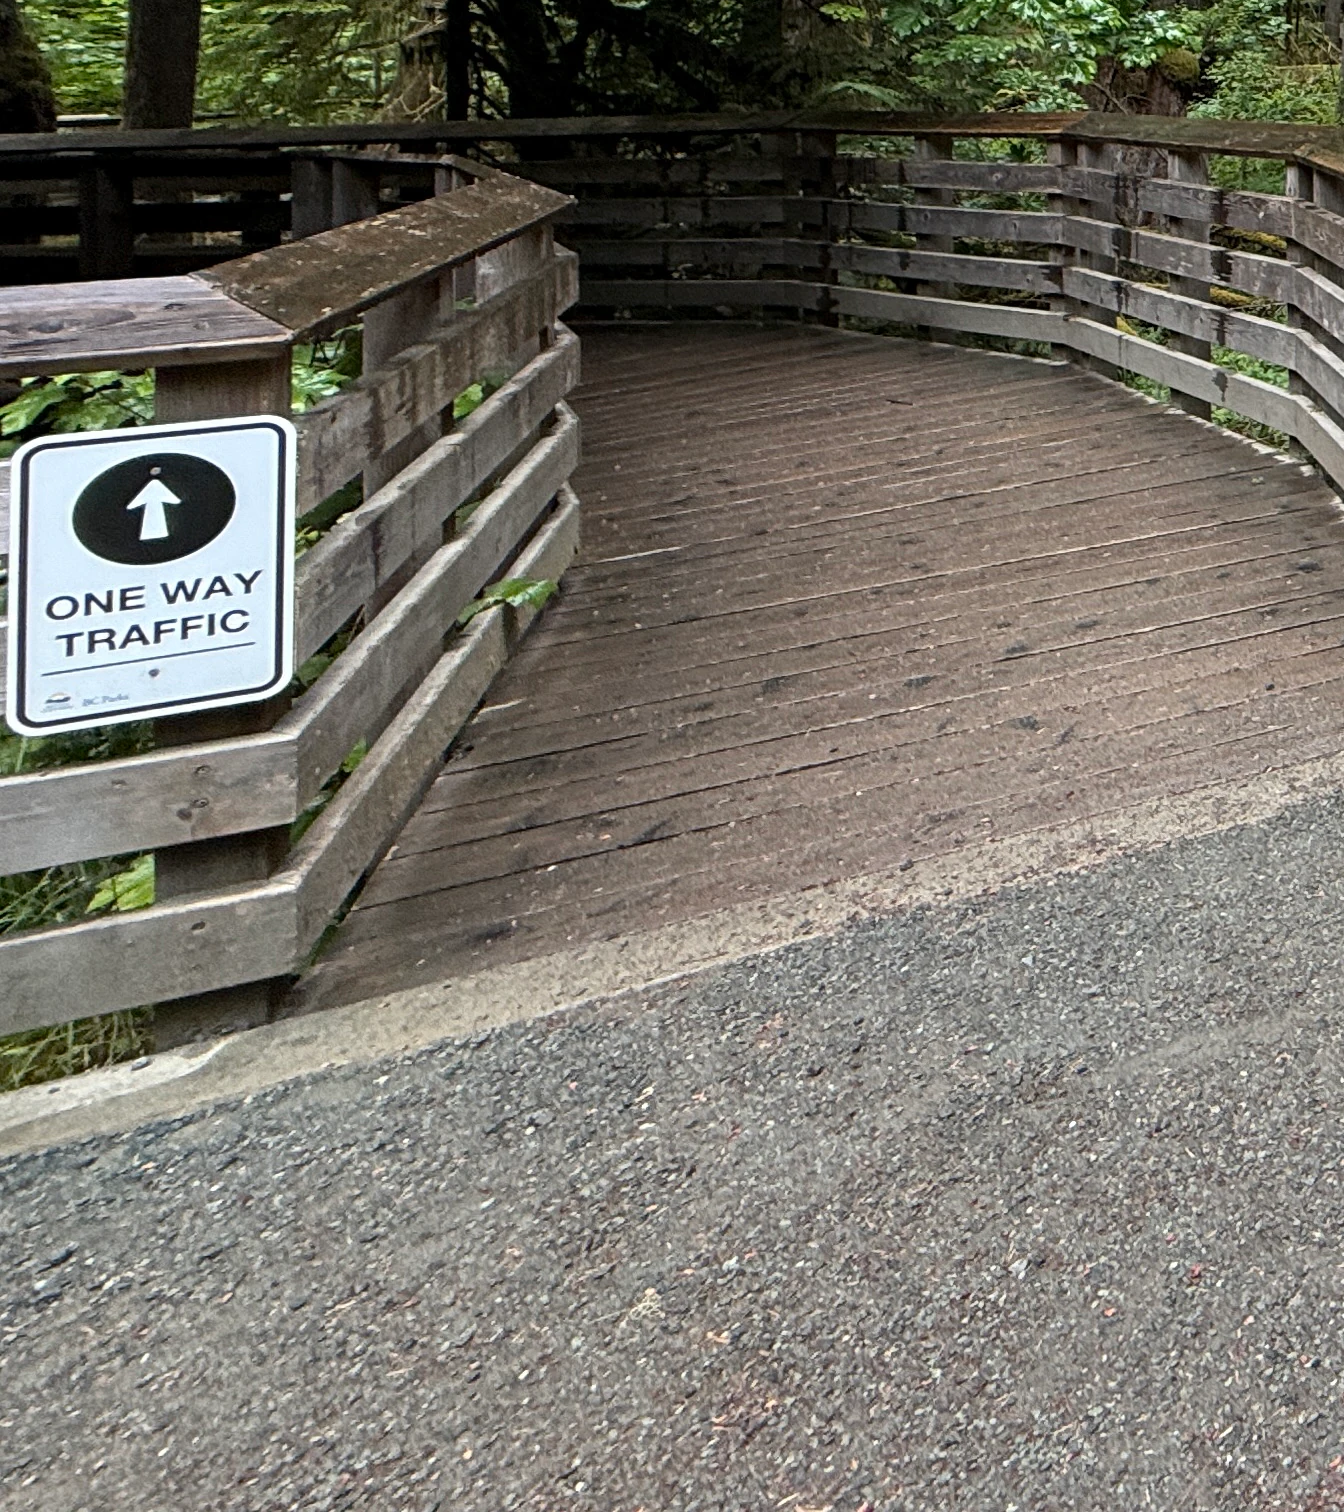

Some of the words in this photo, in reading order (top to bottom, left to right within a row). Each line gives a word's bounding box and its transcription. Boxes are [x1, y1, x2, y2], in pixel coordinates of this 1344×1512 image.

[45, 585, 146, 620] ONE
[160, 569, 264, 604] WAY
[55, 609, 250, 657] TRAFFIC
